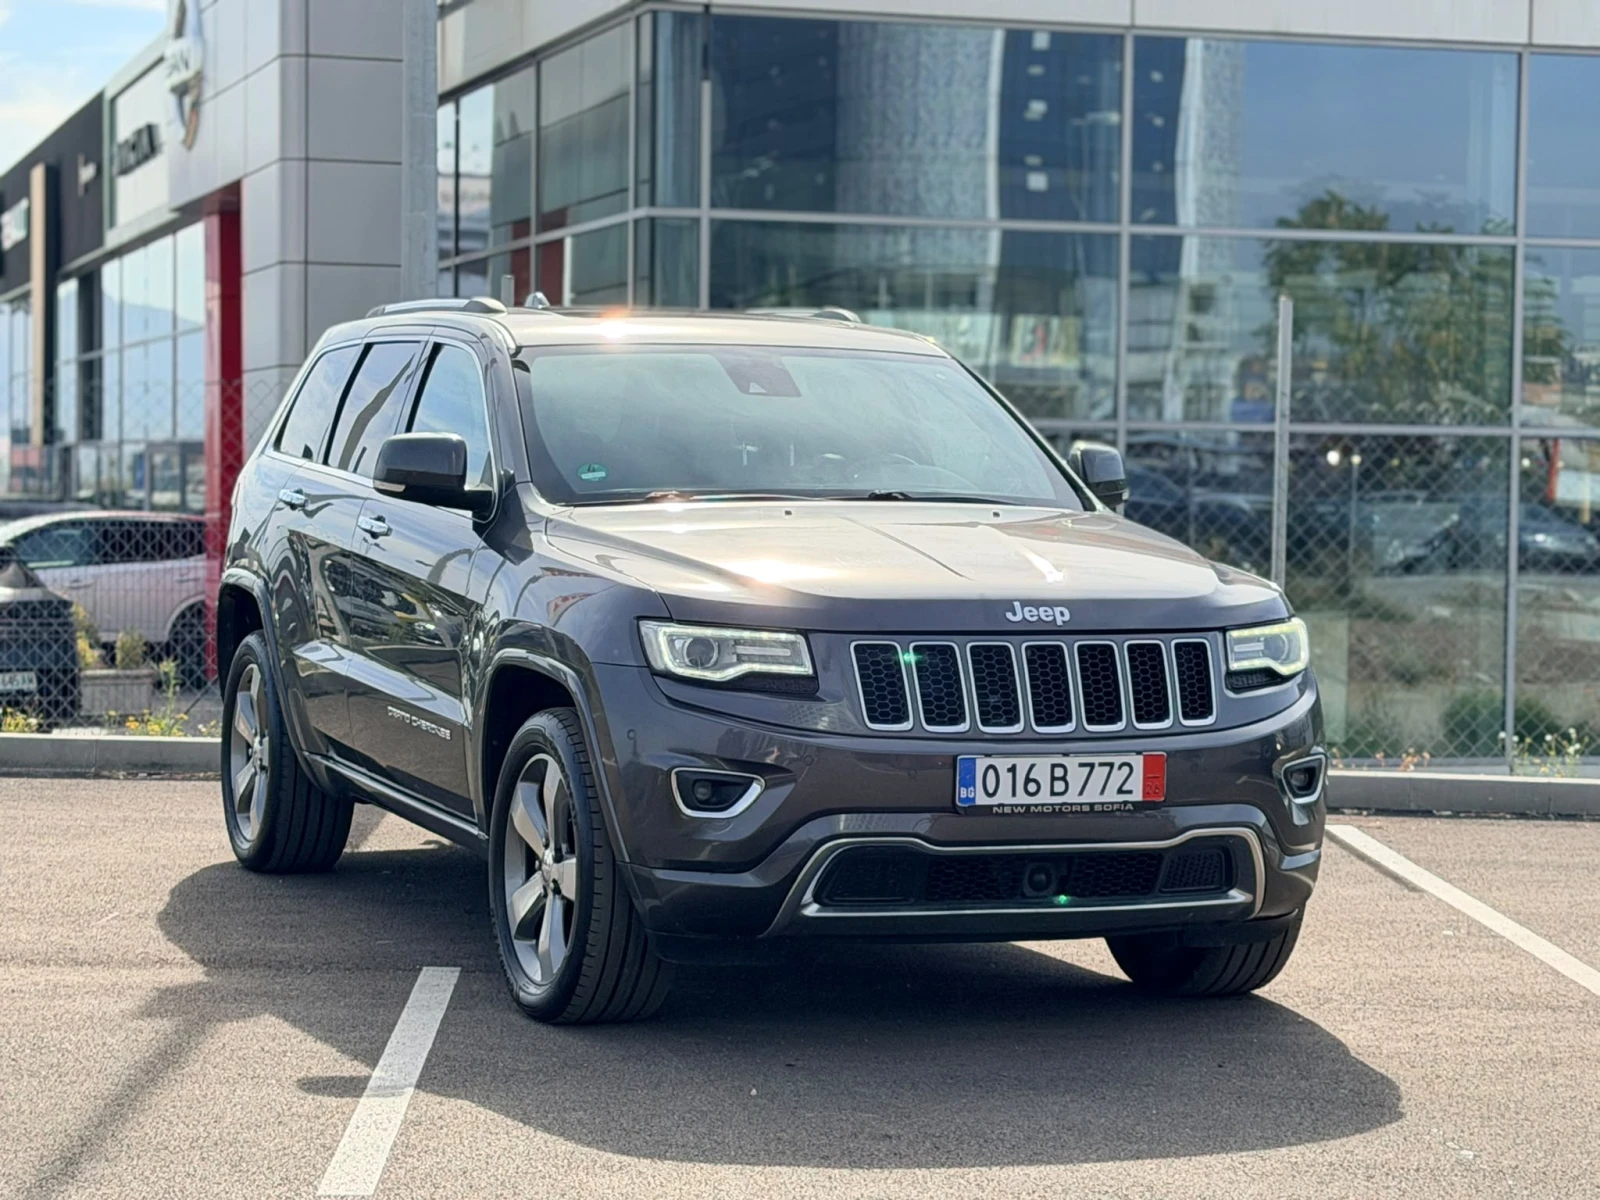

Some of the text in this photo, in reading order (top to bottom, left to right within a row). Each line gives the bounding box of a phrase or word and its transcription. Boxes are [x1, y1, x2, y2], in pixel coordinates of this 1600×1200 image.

[1005, 601, 1071, 626] Jeep
[960, 786, 975, 799] BG
[992, 803, 1135, 814] NEW MOTORS SOFIA
